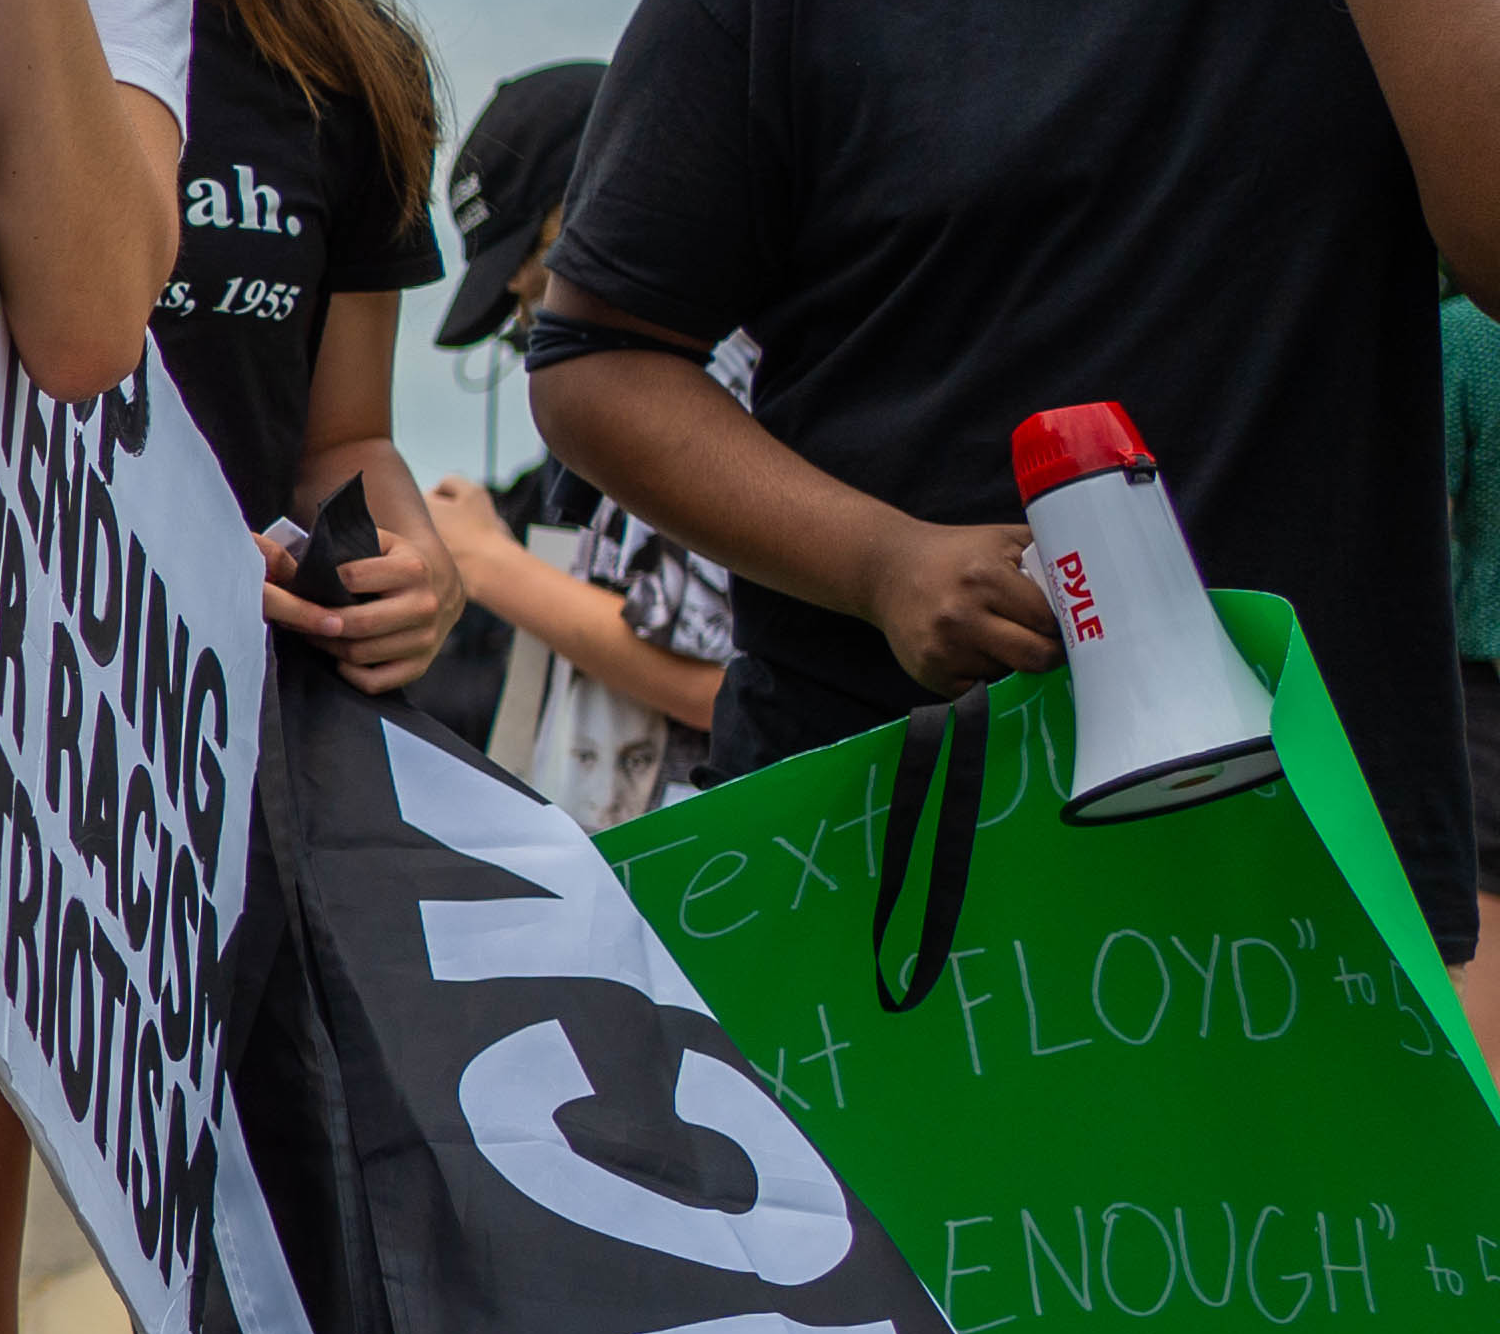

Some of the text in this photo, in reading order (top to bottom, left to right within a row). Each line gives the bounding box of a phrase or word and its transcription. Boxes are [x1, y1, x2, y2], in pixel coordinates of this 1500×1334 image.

[212, 276, 302, 321] 1955
[1056, 551, 1103, 643] PYLE
[46, 622, 228, 1129] RACISM
